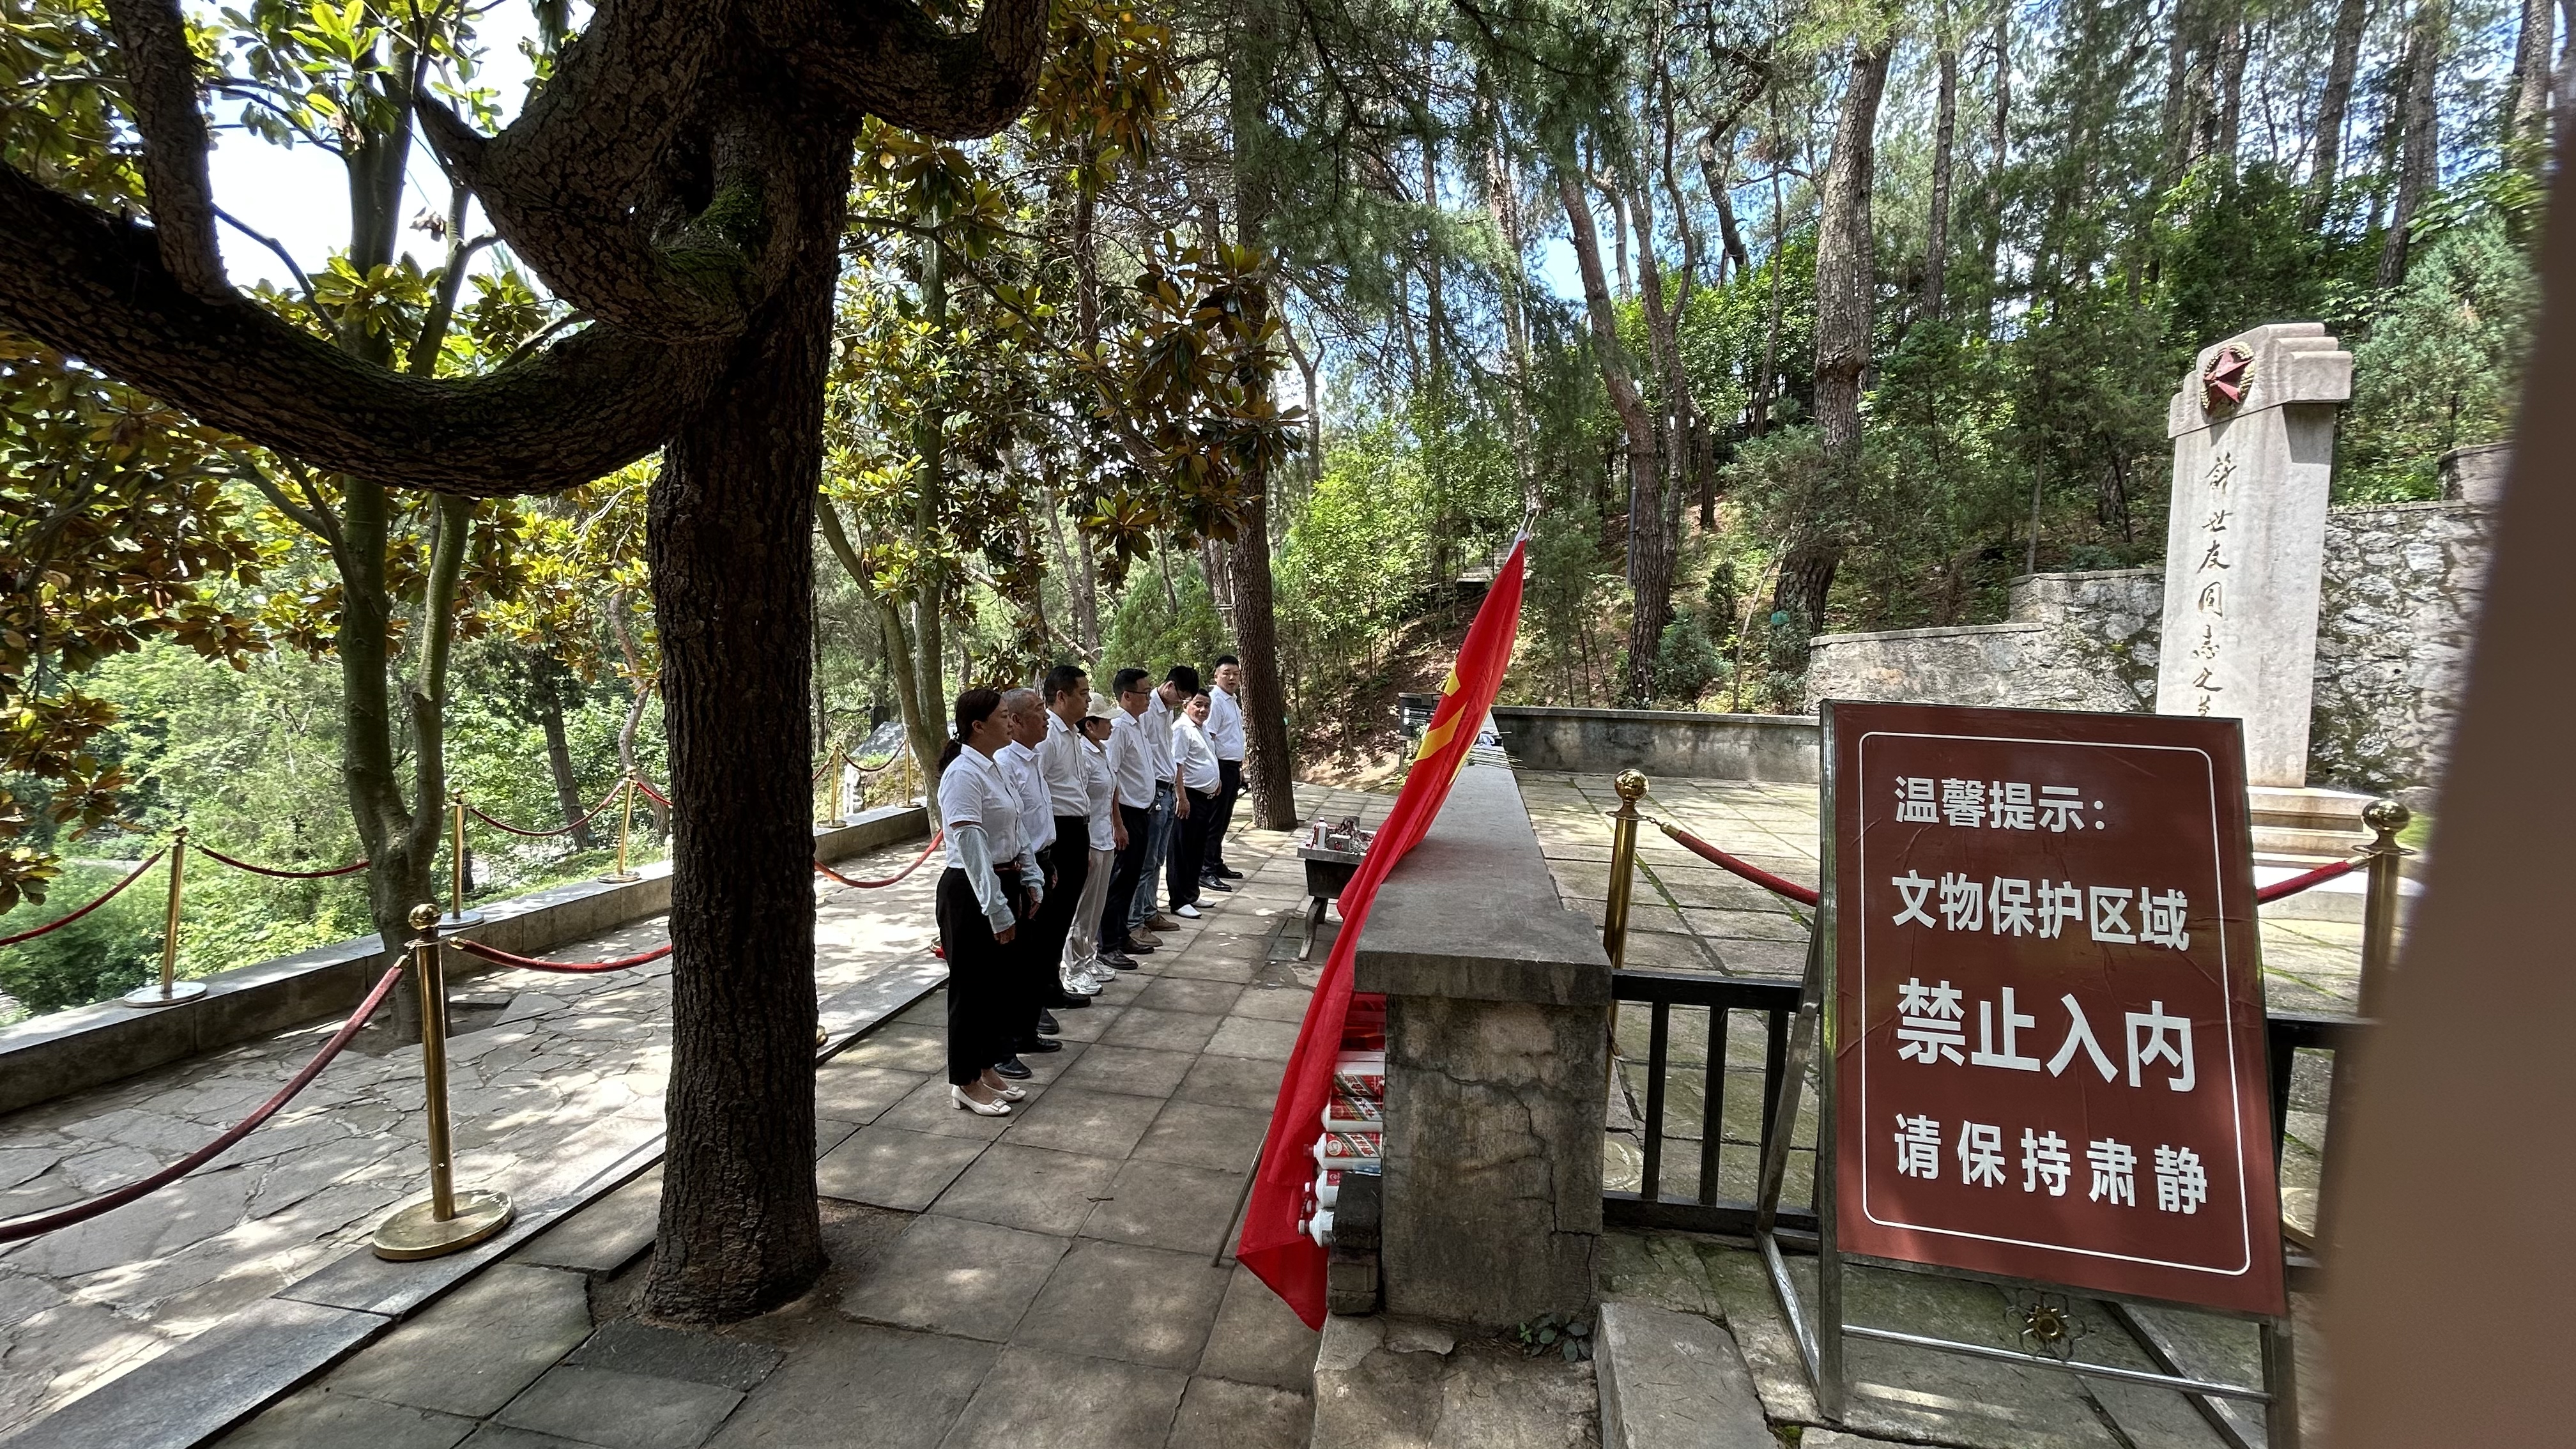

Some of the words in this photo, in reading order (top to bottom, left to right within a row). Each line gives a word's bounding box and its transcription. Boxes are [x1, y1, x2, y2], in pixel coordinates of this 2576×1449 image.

[1892, 869, 2190, 952] 文物保护区域
[1897, 977, 2196, 1092] 禁止入内
[1894, 1113, 2208, 1215] 请保持肃静
